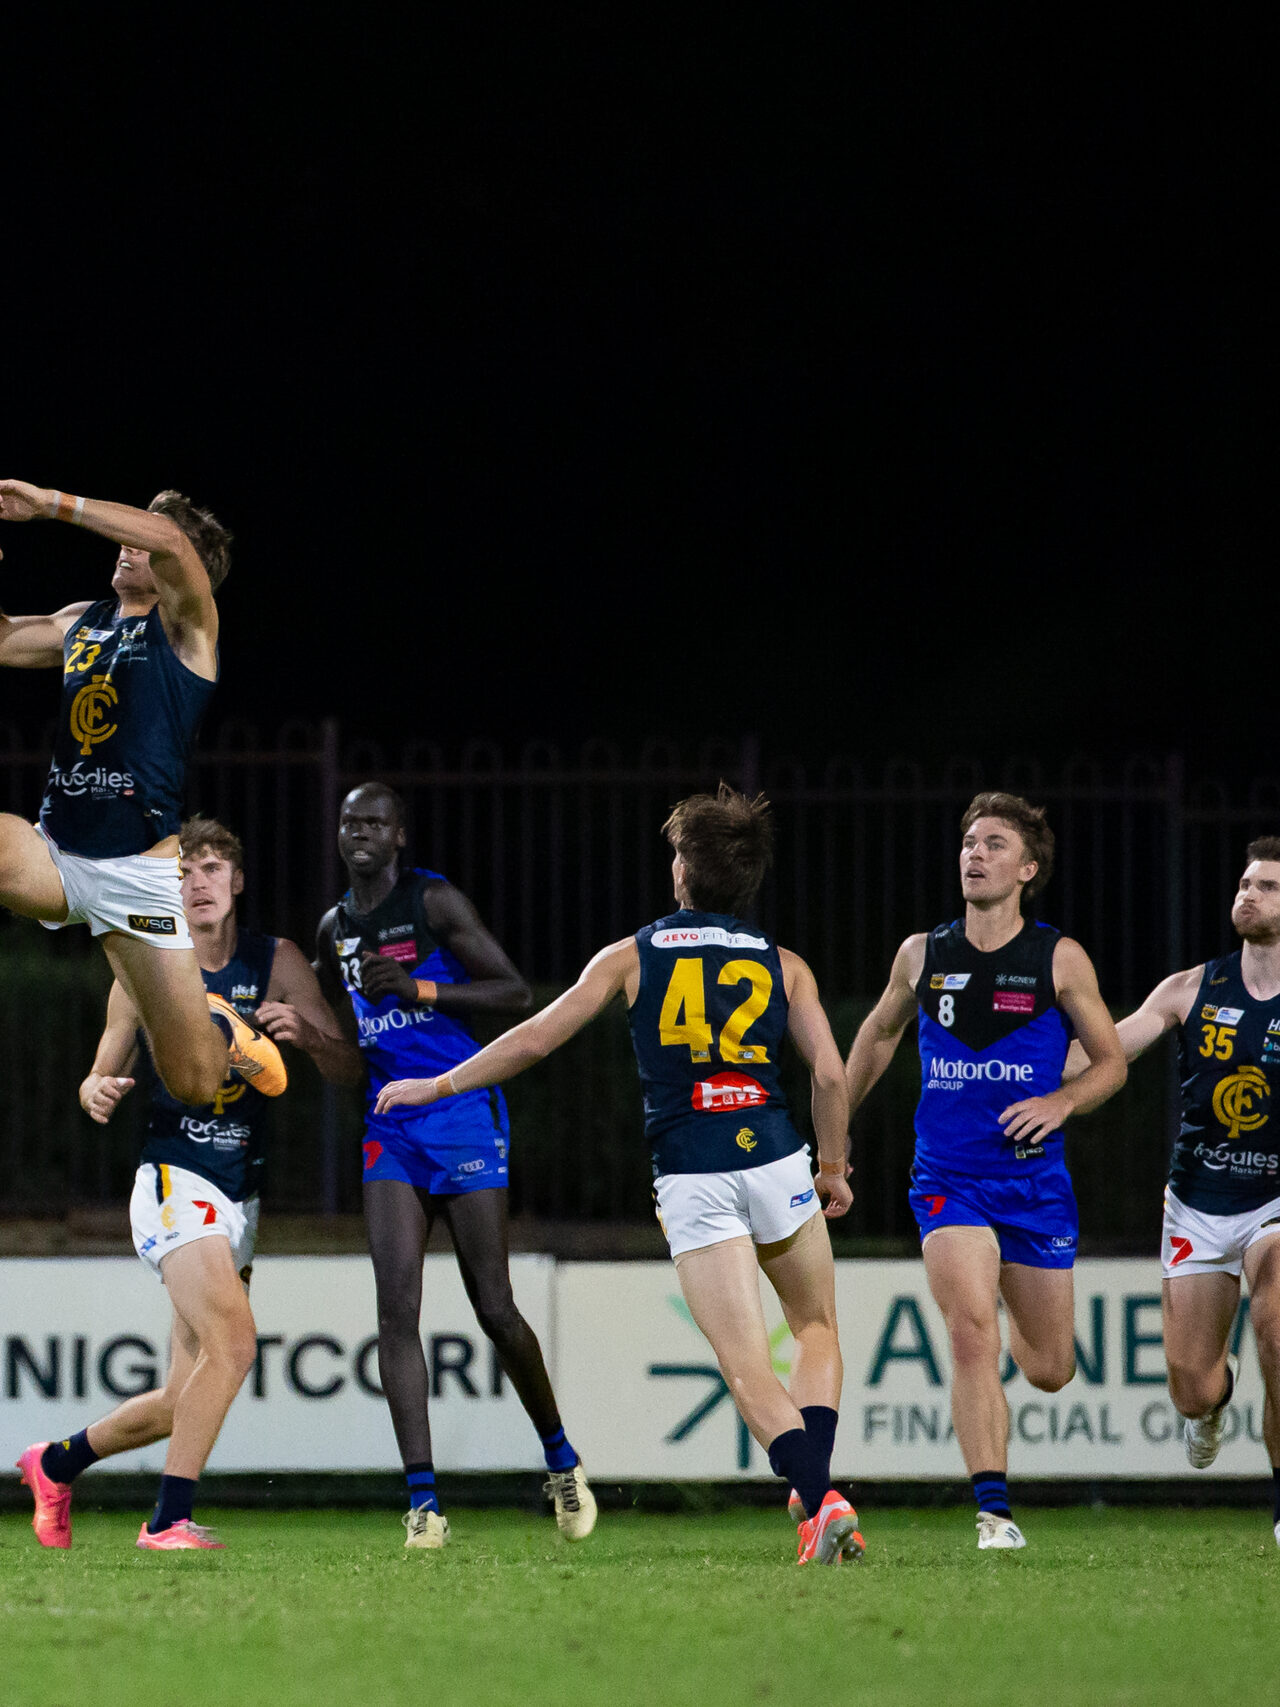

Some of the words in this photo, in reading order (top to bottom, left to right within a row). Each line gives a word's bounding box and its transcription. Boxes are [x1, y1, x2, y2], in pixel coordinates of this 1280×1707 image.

[65, 642, 101, 673] 23
[132, 916, 173, 931] WSG
[358, 1006, 434, 1037] otorOne
[659, 958, 772, 1063] 42
[938, 994, 954, 1027] 8
[1198, 1024, 1237, 1060] 35
[927, 1079, 964, 1090] GROUP
[930, 1057, 1033, 1081] MotorOne
[864, 1402, 1122, 1443] FINCIAL
